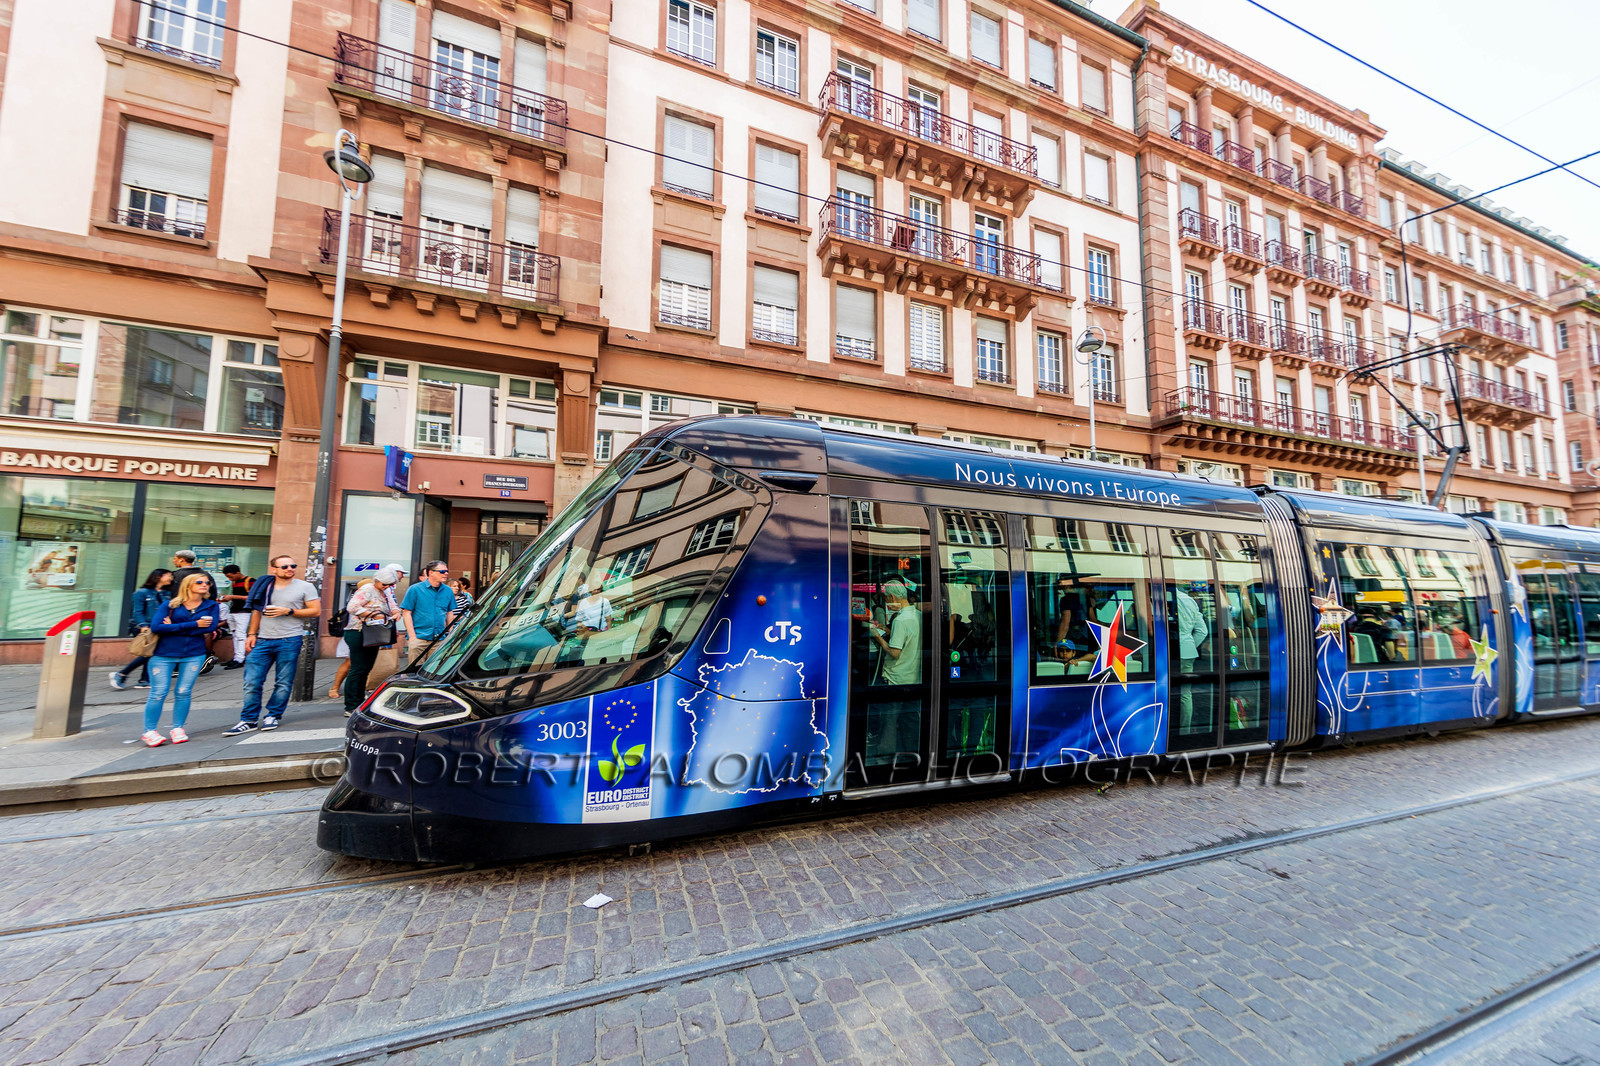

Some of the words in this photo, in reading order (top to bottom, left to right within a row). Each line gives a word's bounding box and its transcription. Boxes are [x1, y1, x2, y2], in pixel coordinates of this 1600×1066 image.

[1171, 44, 1283, 113] STRASBOURG
[1295, 106, 1358, 149] BUILDING
[1, 451, 119, 473] BANQUE
[124, 459, 259, 482] POPULAIRE
[955, 462, 1017, 488] Nous
[1024, 472, 1095, 497] vivons
[1100, 480, 1182, 508] l'Europe
[537, 720, 588, 742] 3003
[350, 738, 380, 756] Europa
[588, 790, 622, 804] EURO
[622, 793, 649, 801] DISTRIKT
[623, 786, 650, 794] DISTRICT
[585, 804, 620, 812] Strasbourg
